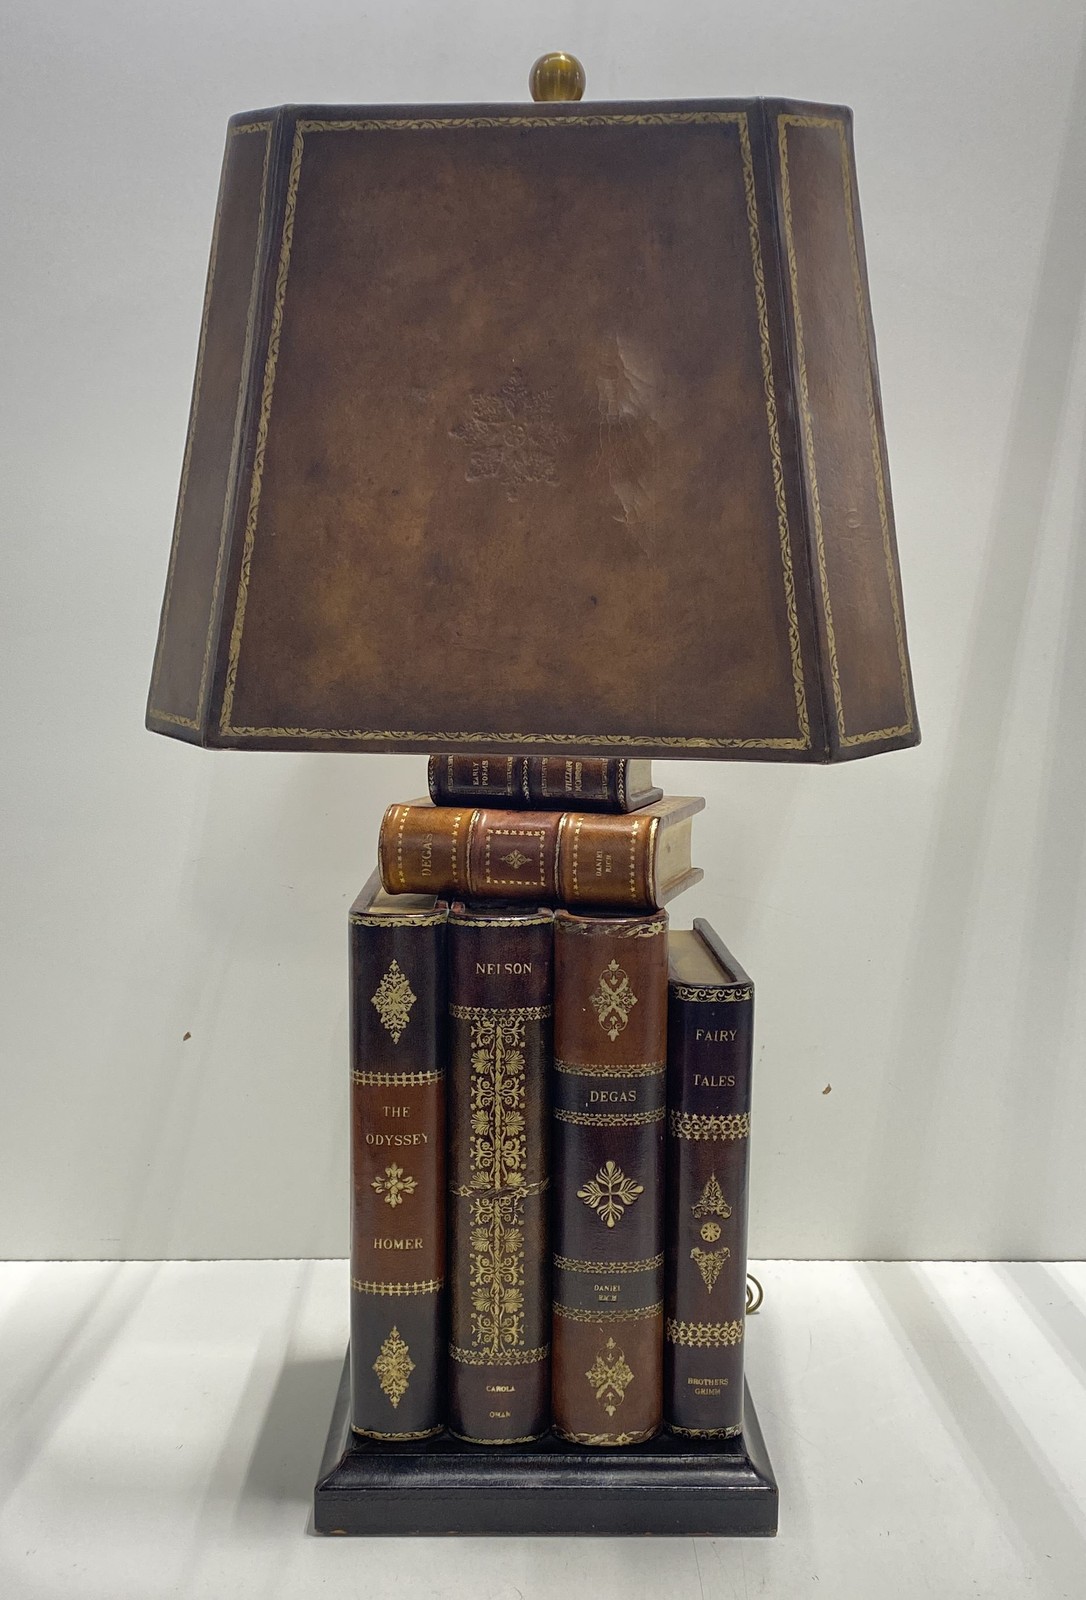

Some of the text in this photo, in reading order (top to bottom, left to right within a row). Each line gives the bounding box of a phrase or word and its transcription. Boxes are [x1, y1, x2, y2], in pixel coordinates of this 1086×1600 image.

[421, 832, 434, 877] DEGAS
[695, 1029, 738, 1042] FAIRY
[693, 1074, 736, 1087] TALES
[589, 1090, 637, 1103] DEGAS
[383, 1105, 411, 1118] THE
[365, 1132, 428, 1146] ODYSSEY
[373, 1238, 424, 1250] HOMER
[593, 1284, 621, 1292] DANIEL
[687, 1377, 729, 1386] BROTHERS
[485, 1385, 516, 1393] CAROLA
